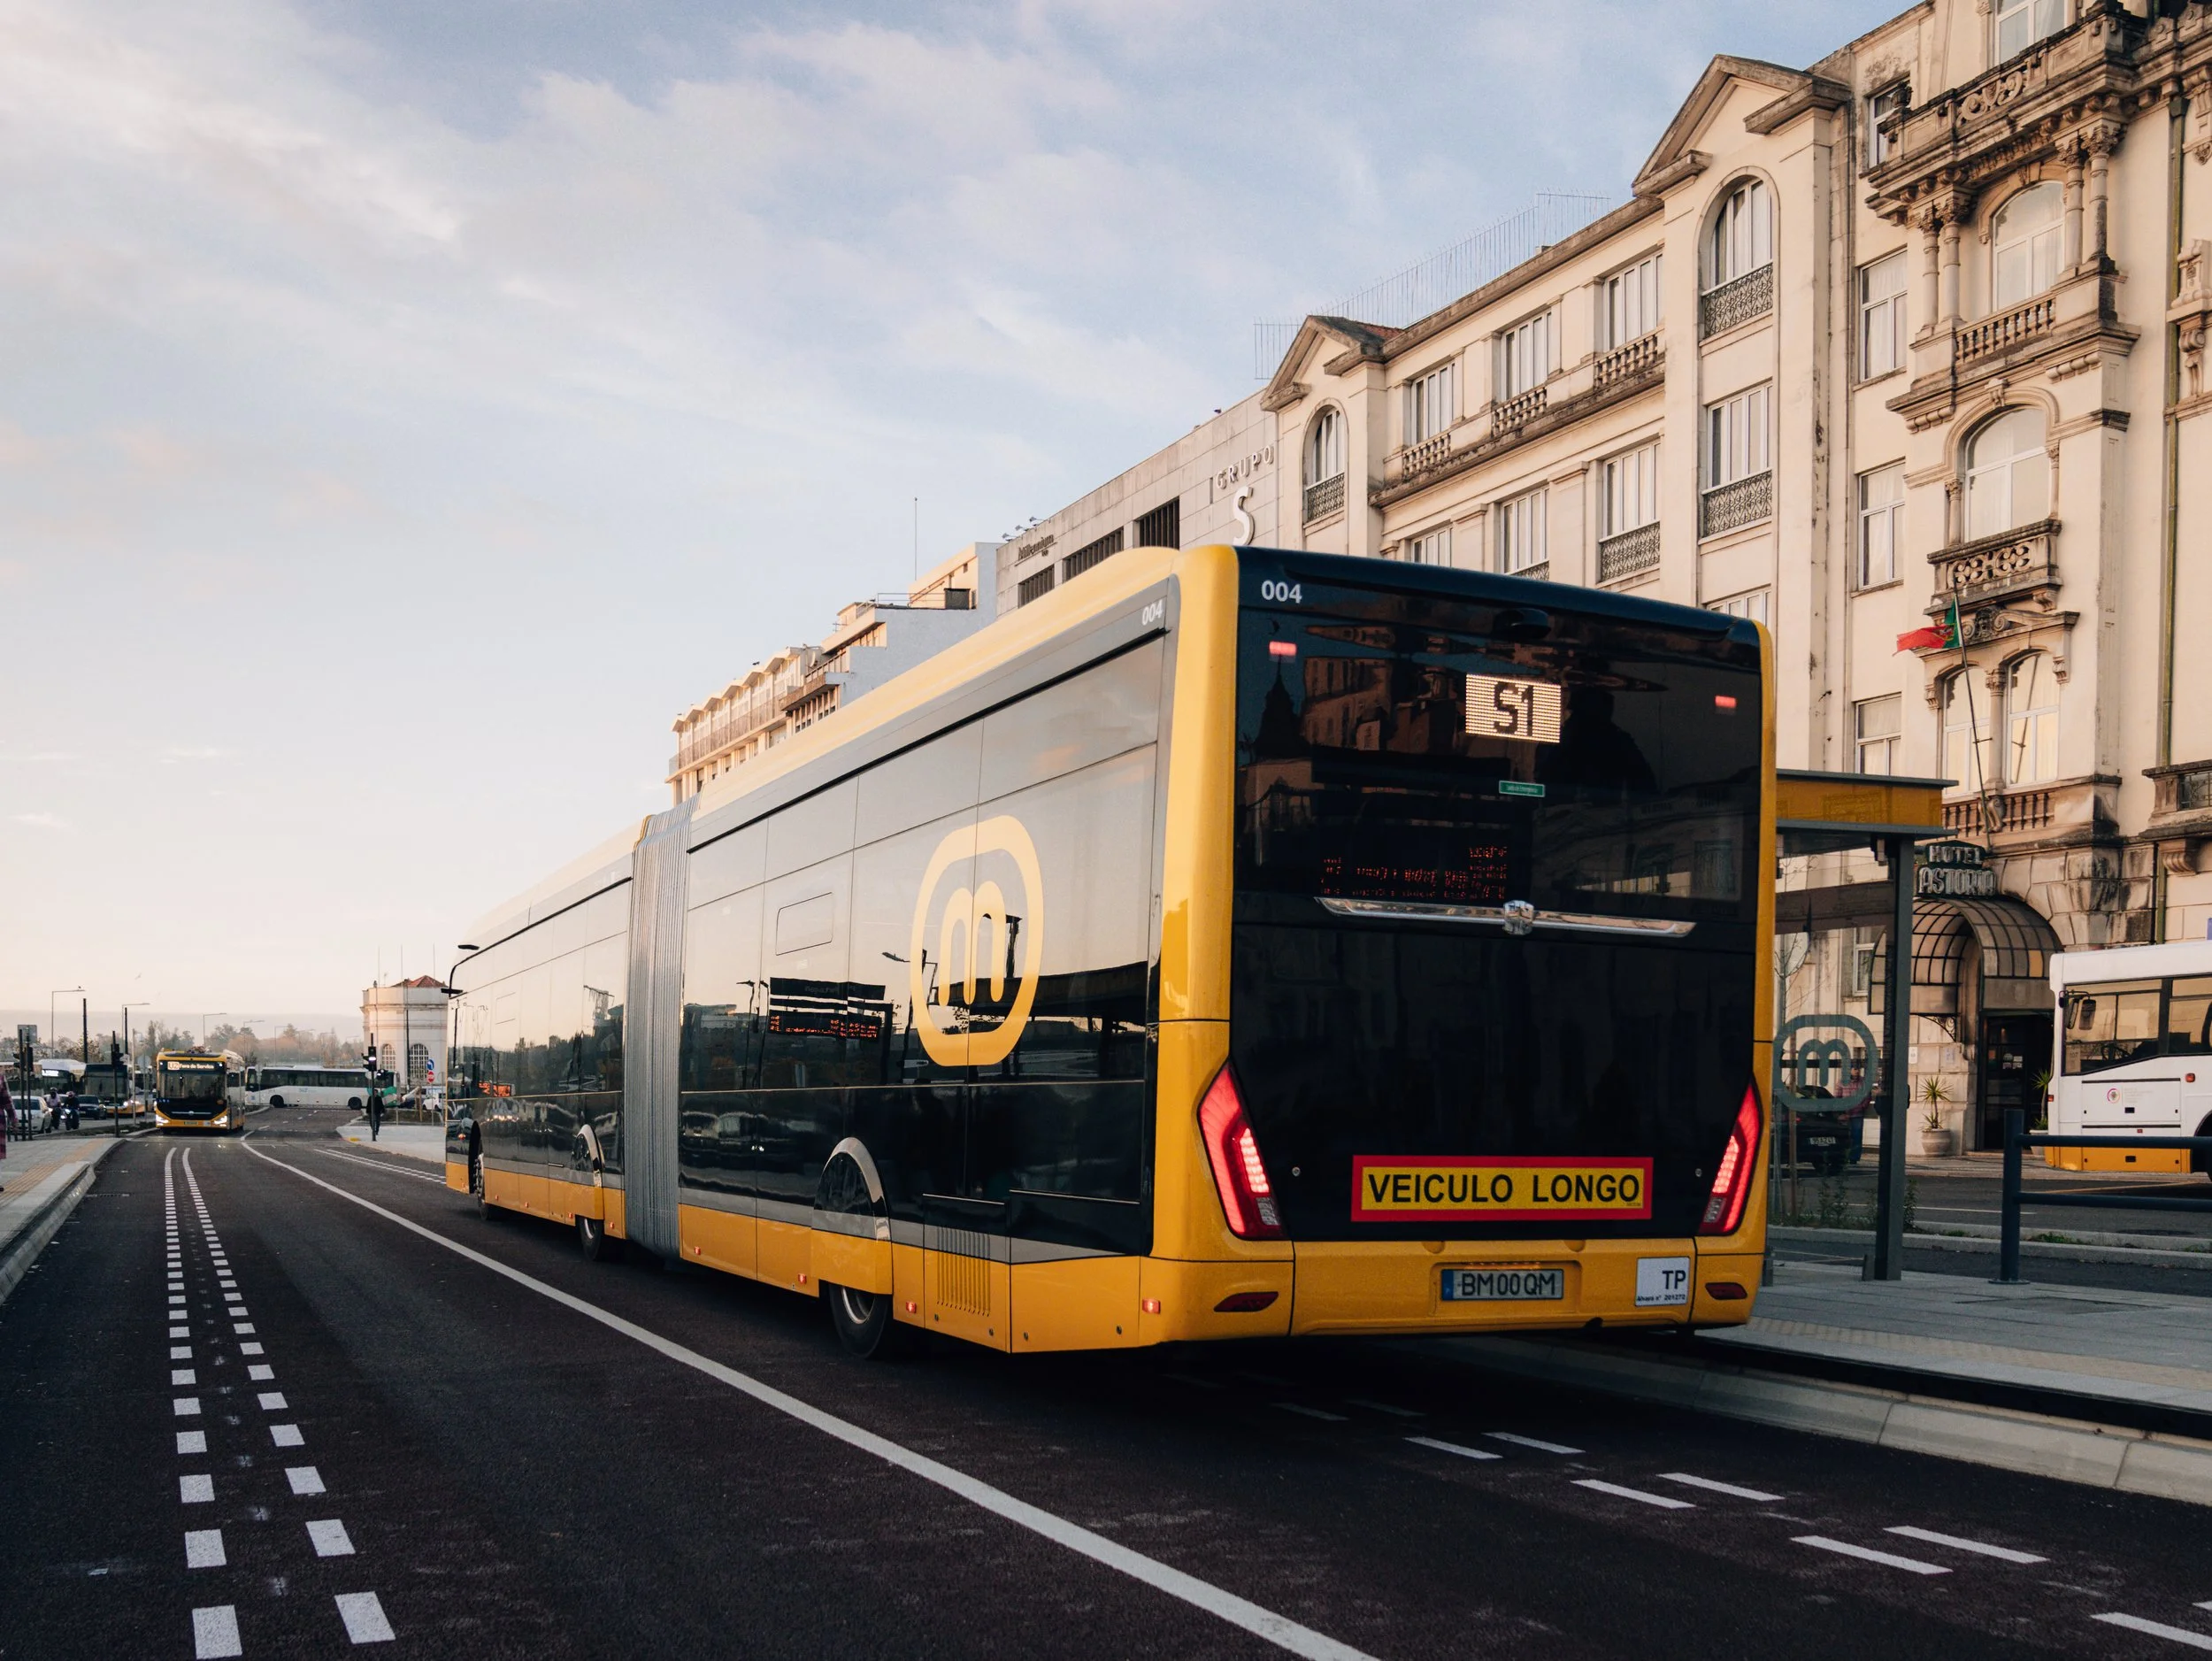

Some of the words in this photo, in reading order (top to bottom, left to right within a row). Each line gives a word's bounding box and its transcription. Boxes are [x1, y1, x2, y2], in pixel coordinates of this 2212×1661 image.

[1217, 445, 1273, 489] GRUPO
[1261, 580, 1302, 604] 004
[1141, 600, 1164, 626] 004
[1494, 681, 1534, 736] S1
[1930, 846, 1982, 865] HOTEL
[1918, 867, 1996, 896] ASTORIA
[1368, 1173, 1513, 1203] VEICULO
[1532, 1174, 1640, 1202] LONGO
[1662, 1270, 1686, 1289] TP
